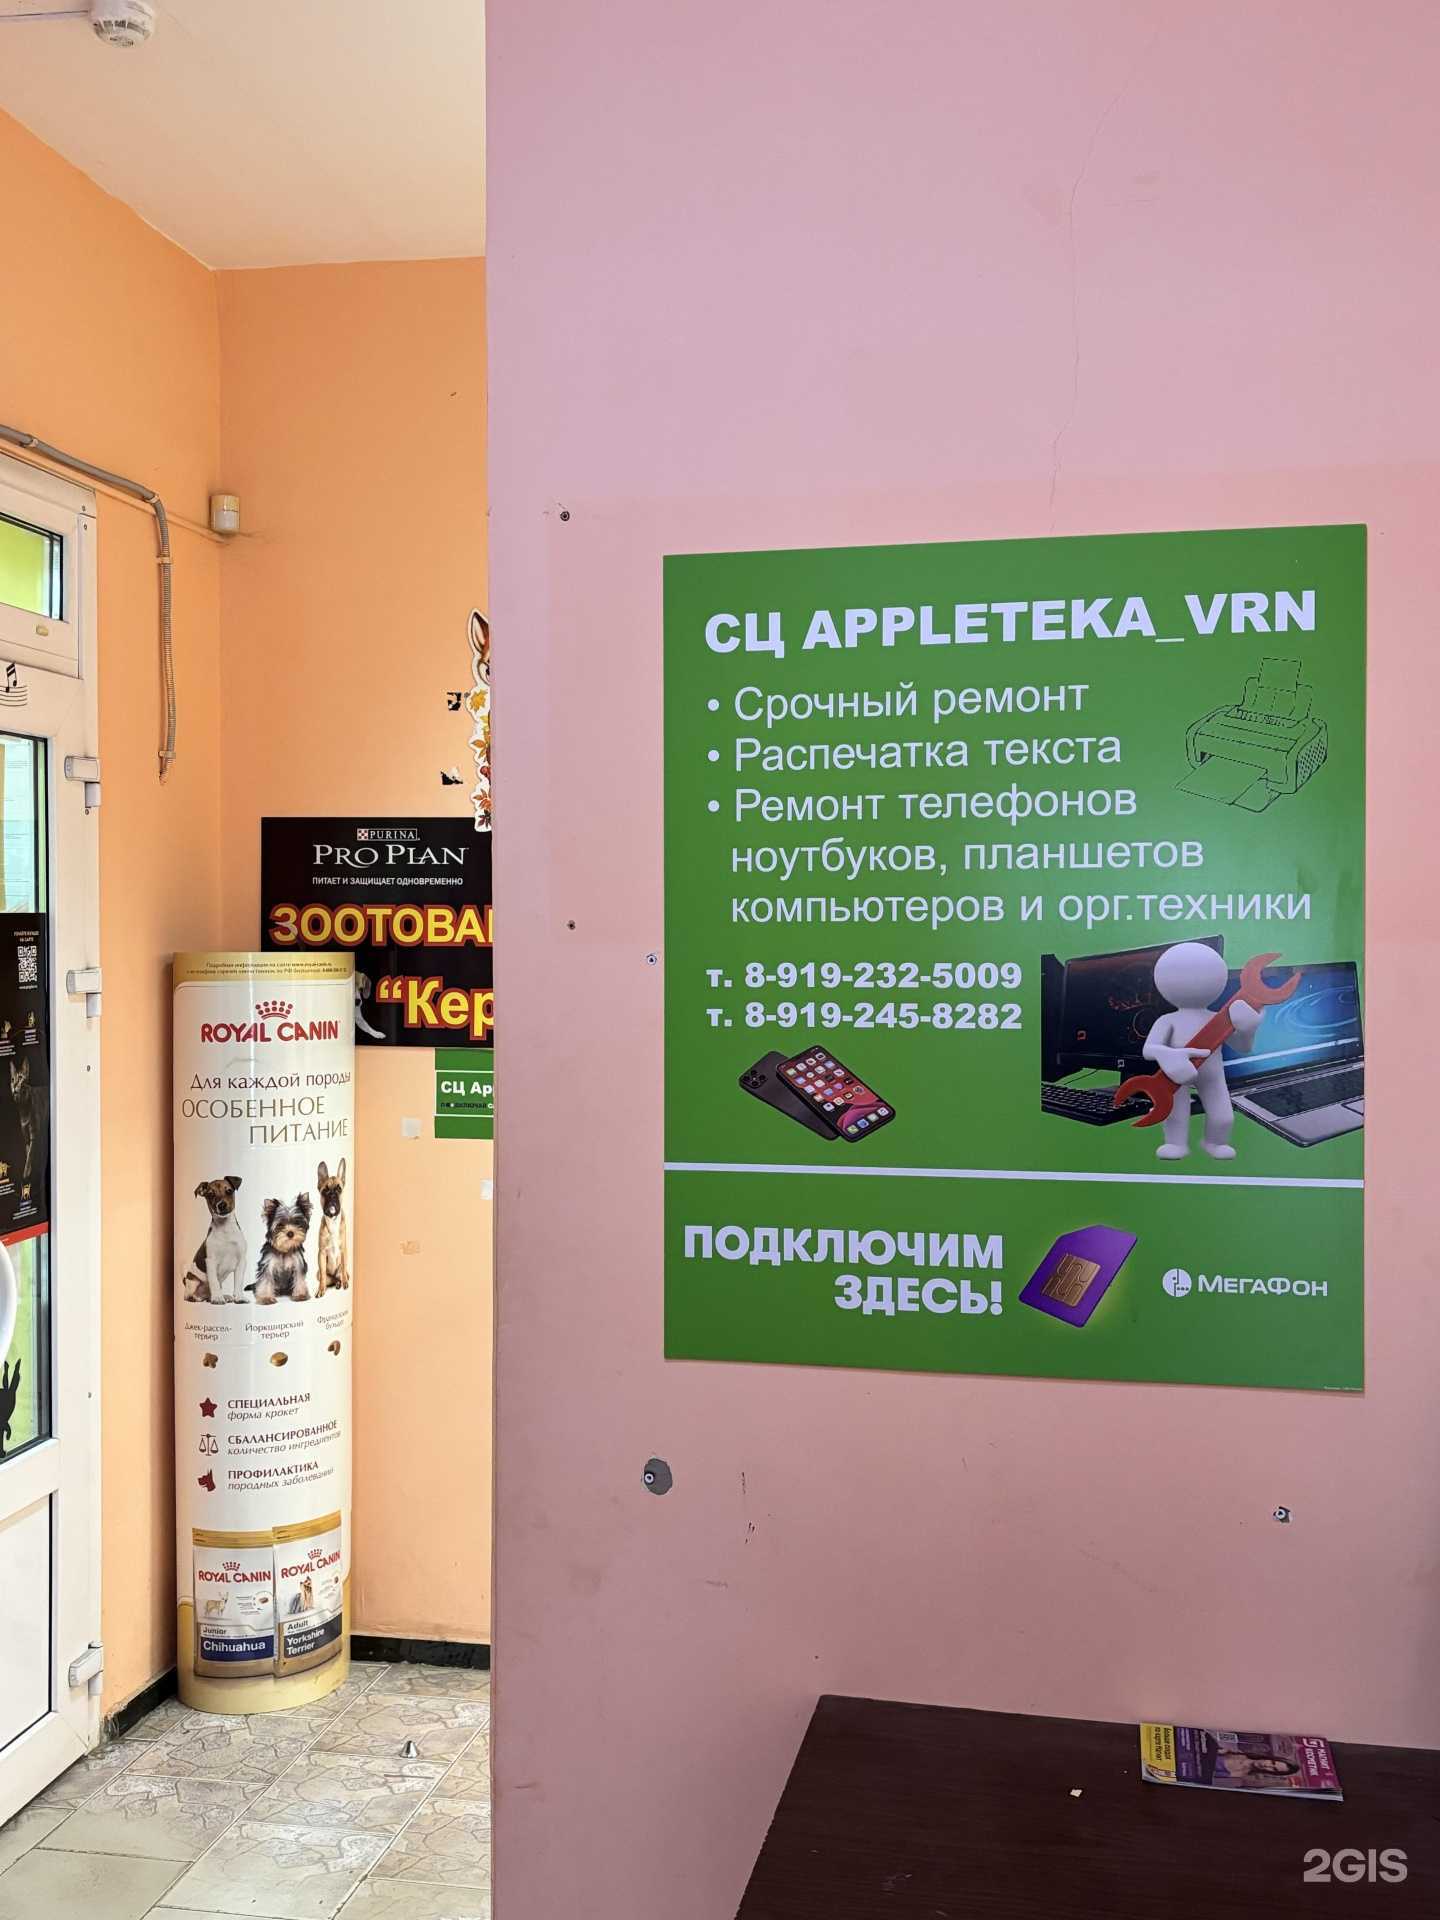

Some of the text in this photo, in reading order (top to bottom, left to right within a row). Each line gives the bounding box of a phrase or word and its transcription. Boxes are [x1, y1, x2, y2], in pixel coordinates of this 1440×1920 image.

[705, 590, 1317, 659] СЦ APPLETEKA_VRN
[734, 682, 1090, 728] Срочный ремонт
[734, 734, 1122, 772] Распечатка текста
[734, 783, 1138, 827] Ремонт телефонов
[370, 830, 416, 840] PURINA
[312, 844, 468, 868] PRO PLAN
[731, 838, 1205, 881] ноутбуков, планшетов
[312, 876, 464, 887] ПИТАЕТ И ЗАЩИЩАЕТ ОДНОВРЕМЕННО
[731, 892, 1312, 930] компьютеров и орг.техники
[270, 904, 493, 946] ЗООТОВА
[706, 961, 1023, 990] т. 8-919-232-5009
[706, 1001, 1023, 1030] т. 8-919-245-8282
[200, 1021, 340, 1043] ROYAL CANIN
[190, 1071, 351, 1091] Для каждой породы
[441, 1081, 466, 1096] СЦ
[181, 1096, 326, 1119] ОСОБЕННОЕ
[249, 1118, 349, 1145] ПИТАНИЕ
[684, 1225, 1004, 1270] ПОДКЛЮЧИМ
[834, 1273, 1004, 1316] ЗДЕСЬ!
[227, 1393, 311, 1410] СПЕЦИАЛЬНАЯ
[227, 1406, 299, 1421] форма крокет
[227, 1419, 338, 1445] СБАЛАНСИРОВАННОЕ
[227, 1445, 287, 1456] количество
[228, 1460, 319, 1480] ПРОФИЛАКТИКА
[227, 1480, 280, 1492] породных
[281, 1550, 341, 1579] ROYAL CANIN
[198, 1570, 272, 1583] ROYAL CANIN
[202, 1626, 228, 1636] Junior
[287, 1620, 309, 1631] Adult
[203, 1640, 267, 1653] Chihuahua
[286, 1628, 325, 1646] Yorkshire
[286, 1641, 316, 1656] Terrier
